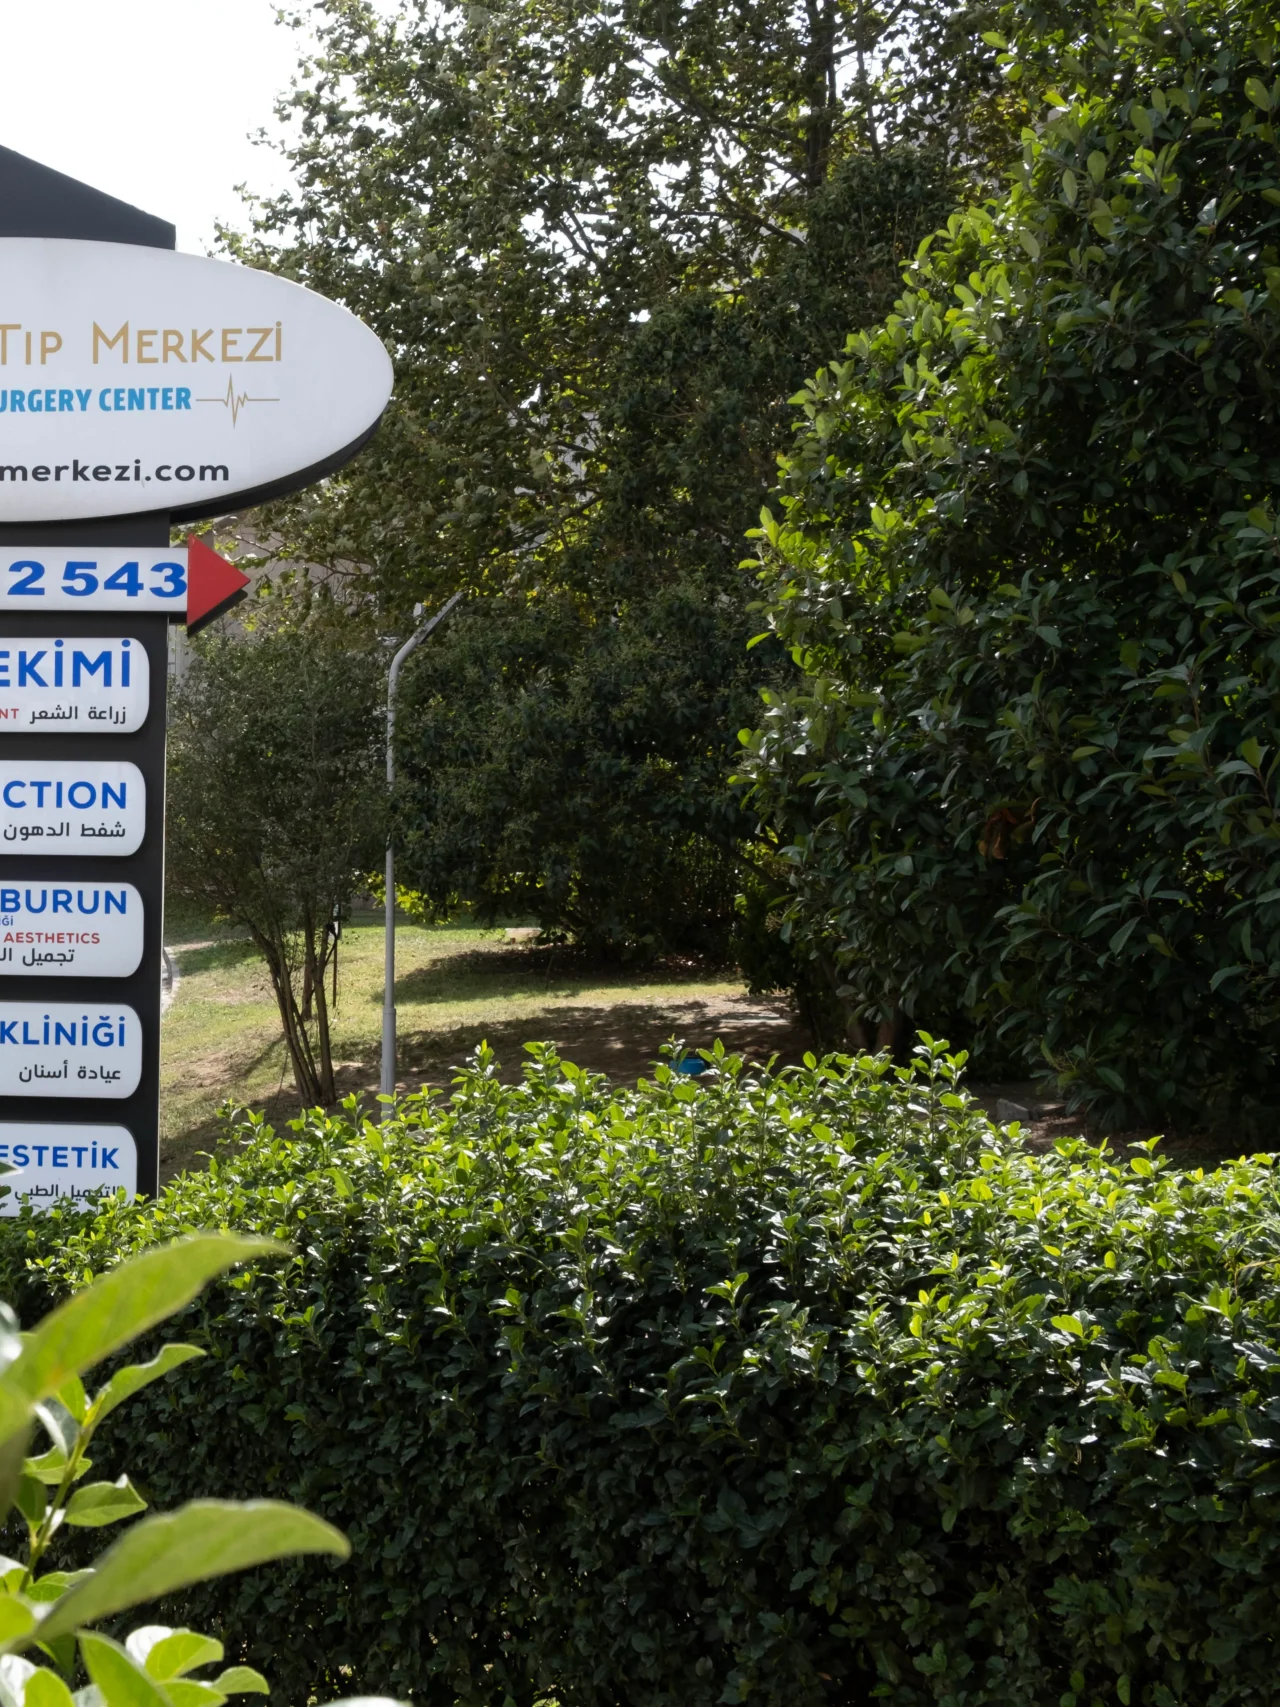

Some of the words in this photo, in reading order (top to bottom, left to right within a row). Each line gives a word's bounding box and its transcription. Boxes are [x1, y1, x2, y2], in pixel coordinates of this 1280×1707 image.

[92, 320, 282, 365] MERKEZİ
[99, 387, 191, 412] CENTER
[29, 704, 78, 725] الشعر
[87, 705, 126, 725] زراعة
[3, 821, 70, 842] الدهون
[80, 821, 126, 838] شفط
[0, 888, 127, 915] BURUN
[3, 932, 101, 944] AESTHETICS
[22, 947, 75, 967] تجميل
[18, 1059, 68, 1083] أسنان
[77, 1065, 121, 1084] عيادة
